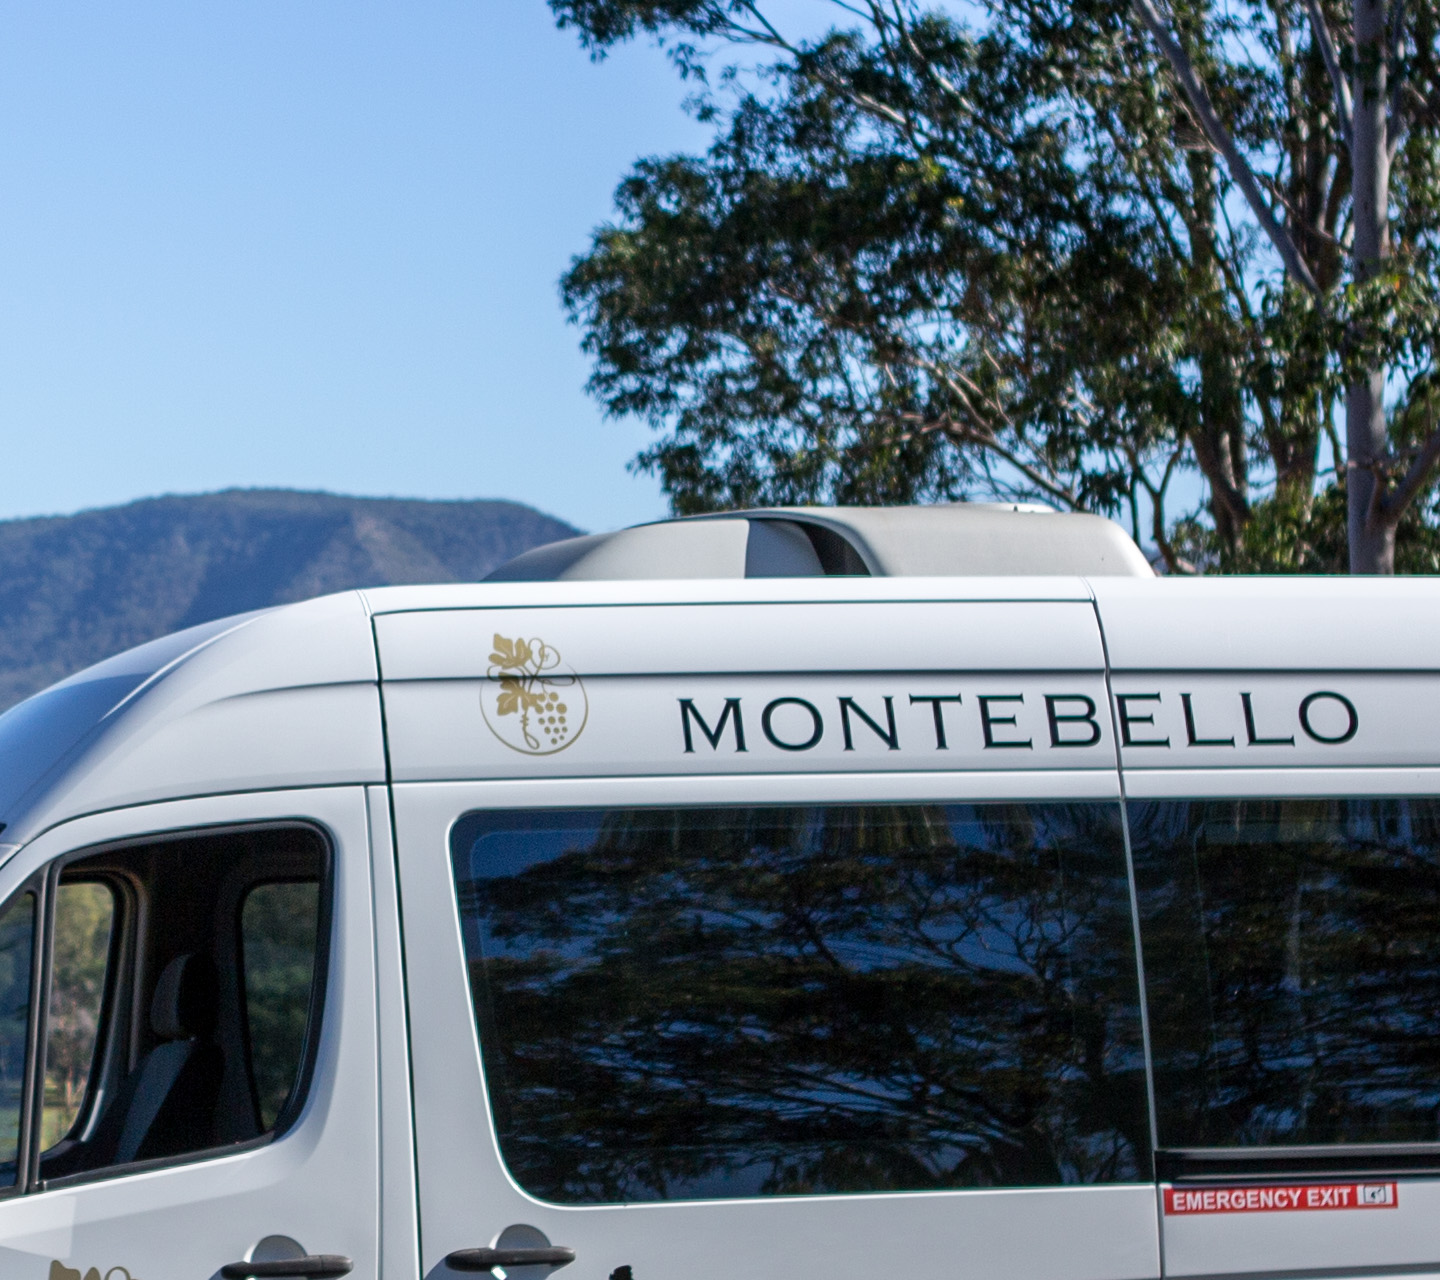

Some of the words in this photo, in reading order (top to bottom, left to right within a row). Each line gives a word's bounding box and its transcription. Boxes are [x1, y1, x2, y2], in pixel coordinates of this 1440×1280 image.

[676, 691, 1359, 754] MONTEBELLO
[1173, 1188, 1302, 1211] EMERGENCY
[1307, 1188, 1351, 1207] EXIT
